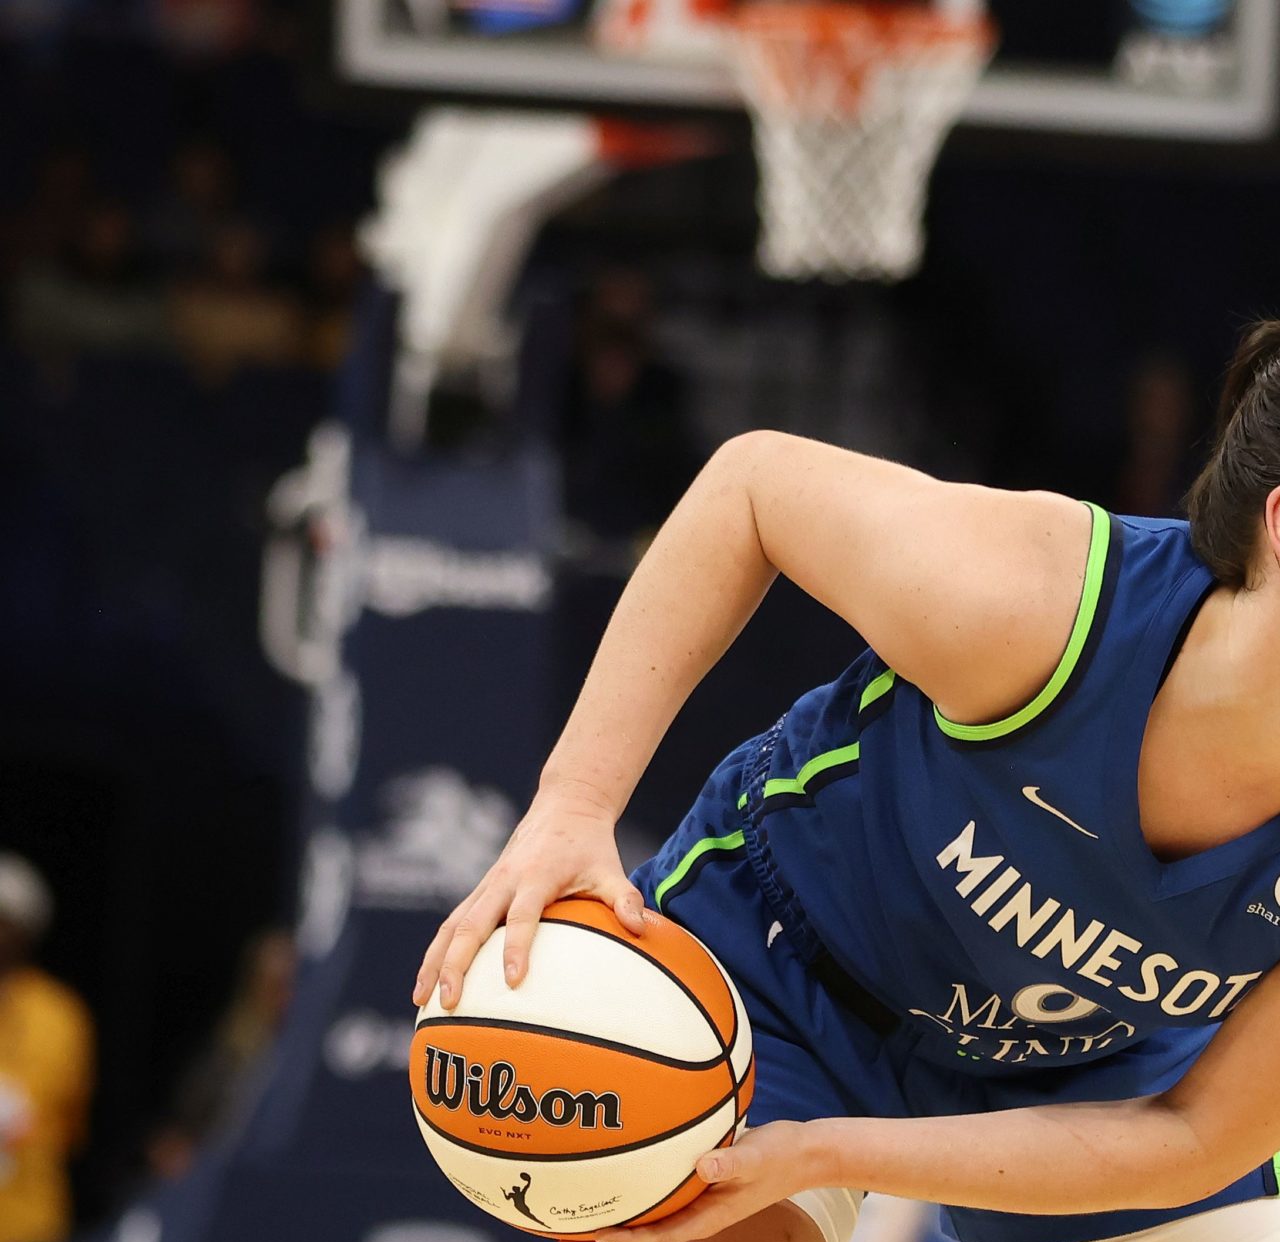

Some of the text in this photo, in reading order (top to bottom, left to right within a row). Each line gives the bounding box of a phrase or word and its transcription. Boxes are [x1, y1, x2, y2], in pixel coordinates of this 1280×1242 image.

[935, 820, 1263, 1018] MINNESOT
[424, 1044, 623, 1129] Wilson
[478, 1127, 531, 1140] EVO NXT
